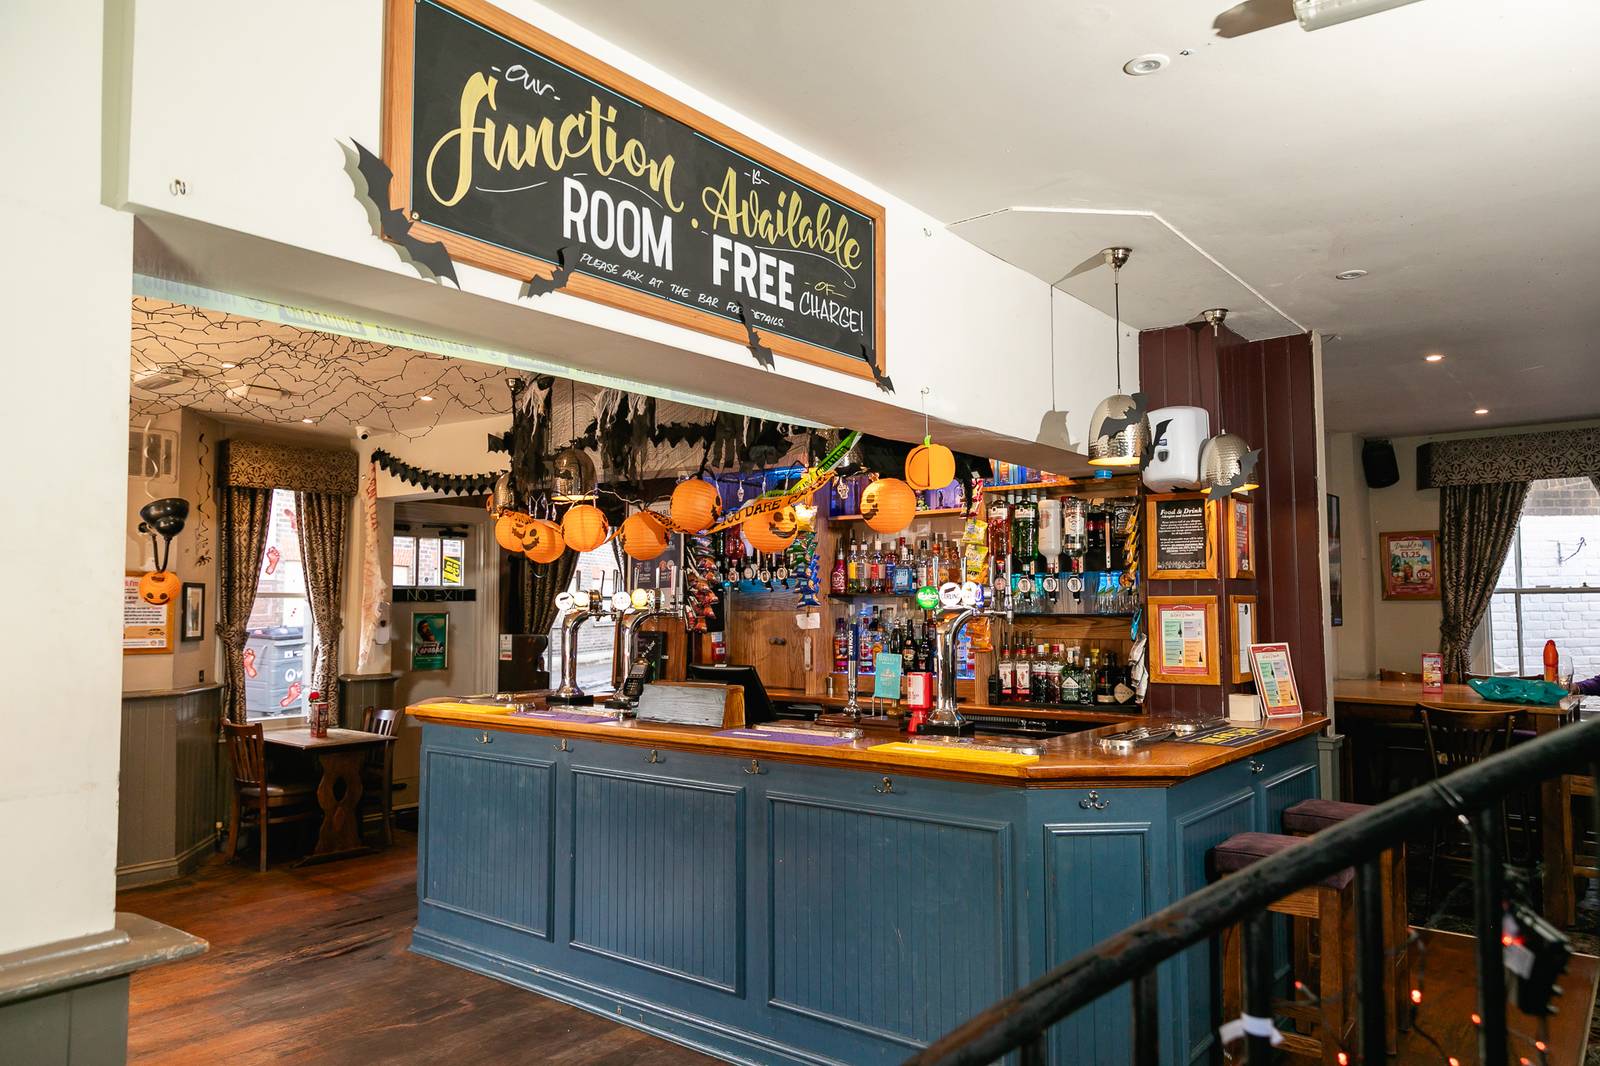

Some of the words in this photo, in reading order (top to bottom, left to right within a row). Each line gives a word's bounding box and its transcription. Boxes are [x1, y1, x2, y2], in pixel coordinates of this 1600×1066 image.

[563, 176, 673, 271] ROOM
[701, 166, 863, 270] Available
[580, 253, 620, 275] PLEASE
[622, 269, 644, 284] ASK
[648, 277, 664, 289] AT
[670, 283, 691, 298] THE
[698, 293, 719, 309] BAR
[712, 234, 795, 312] FREE
[799, 291, 865, 337] CHARGE!
[745, 500, 782, 519] DARE
[406, 589, 428, 601] NO
